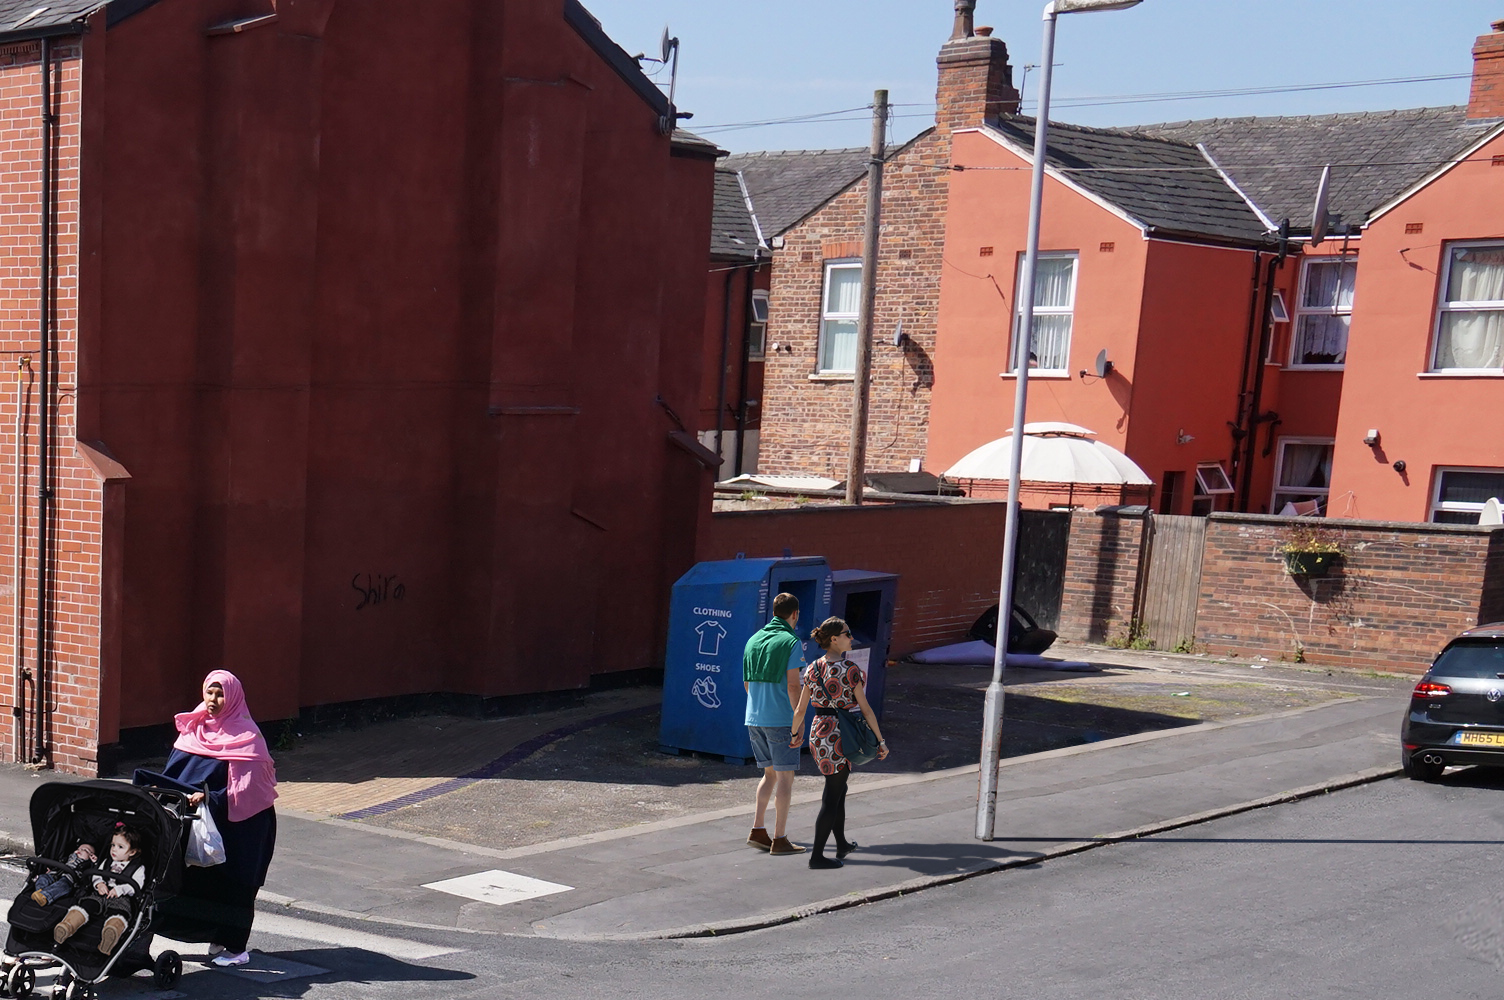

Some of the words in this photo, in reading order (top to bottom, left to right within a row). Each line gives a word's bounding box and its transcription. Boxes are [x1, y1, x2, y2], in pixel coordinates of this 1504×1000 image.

[693, 607, 732, 618] CLOTHING
[695, 662, 721, 673] SHOES
[1463, 732, 1493, 744] MH65
[1496, 733, 1504, 744] L
